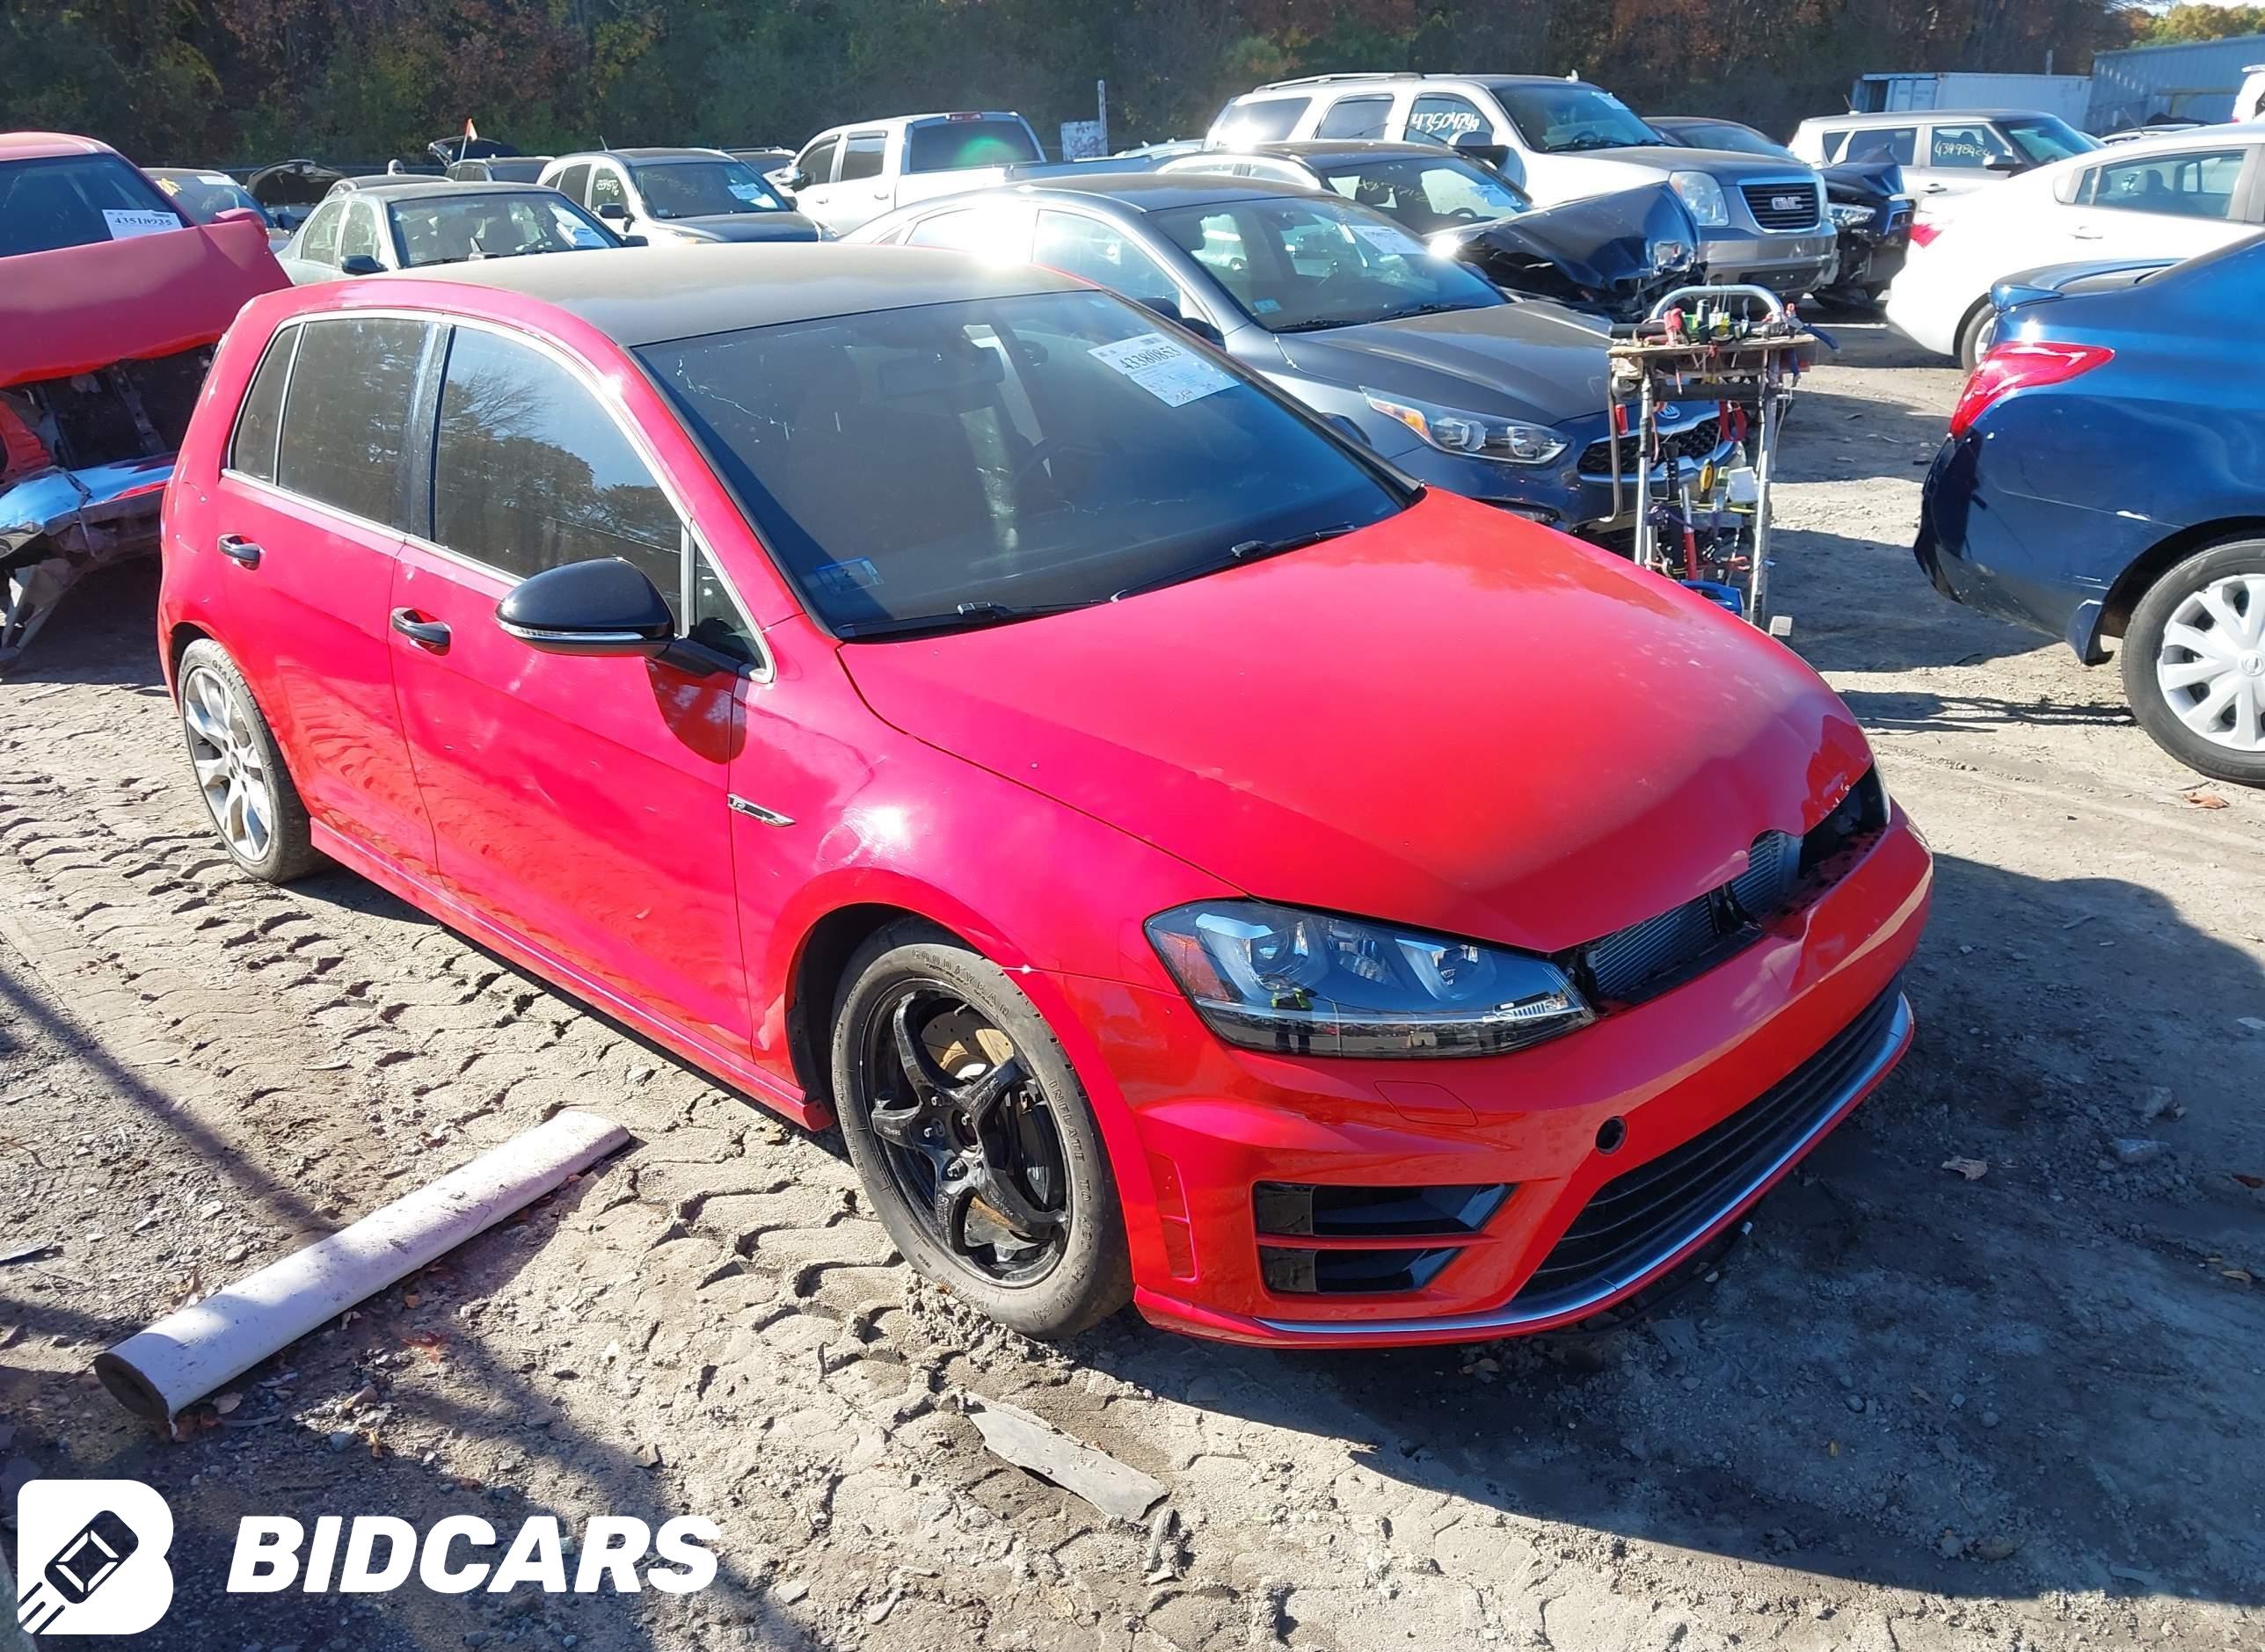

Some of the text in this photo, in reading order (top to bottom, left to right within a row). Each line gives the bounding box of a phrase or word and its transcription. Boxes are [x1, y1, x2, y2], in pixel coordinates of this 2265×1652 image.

[1119, 346, 1182, 370] 43380853
[912, 949, 1009, 1017] GOODYEAR
[1048, 1080, 1086, 1162] INFLATE
